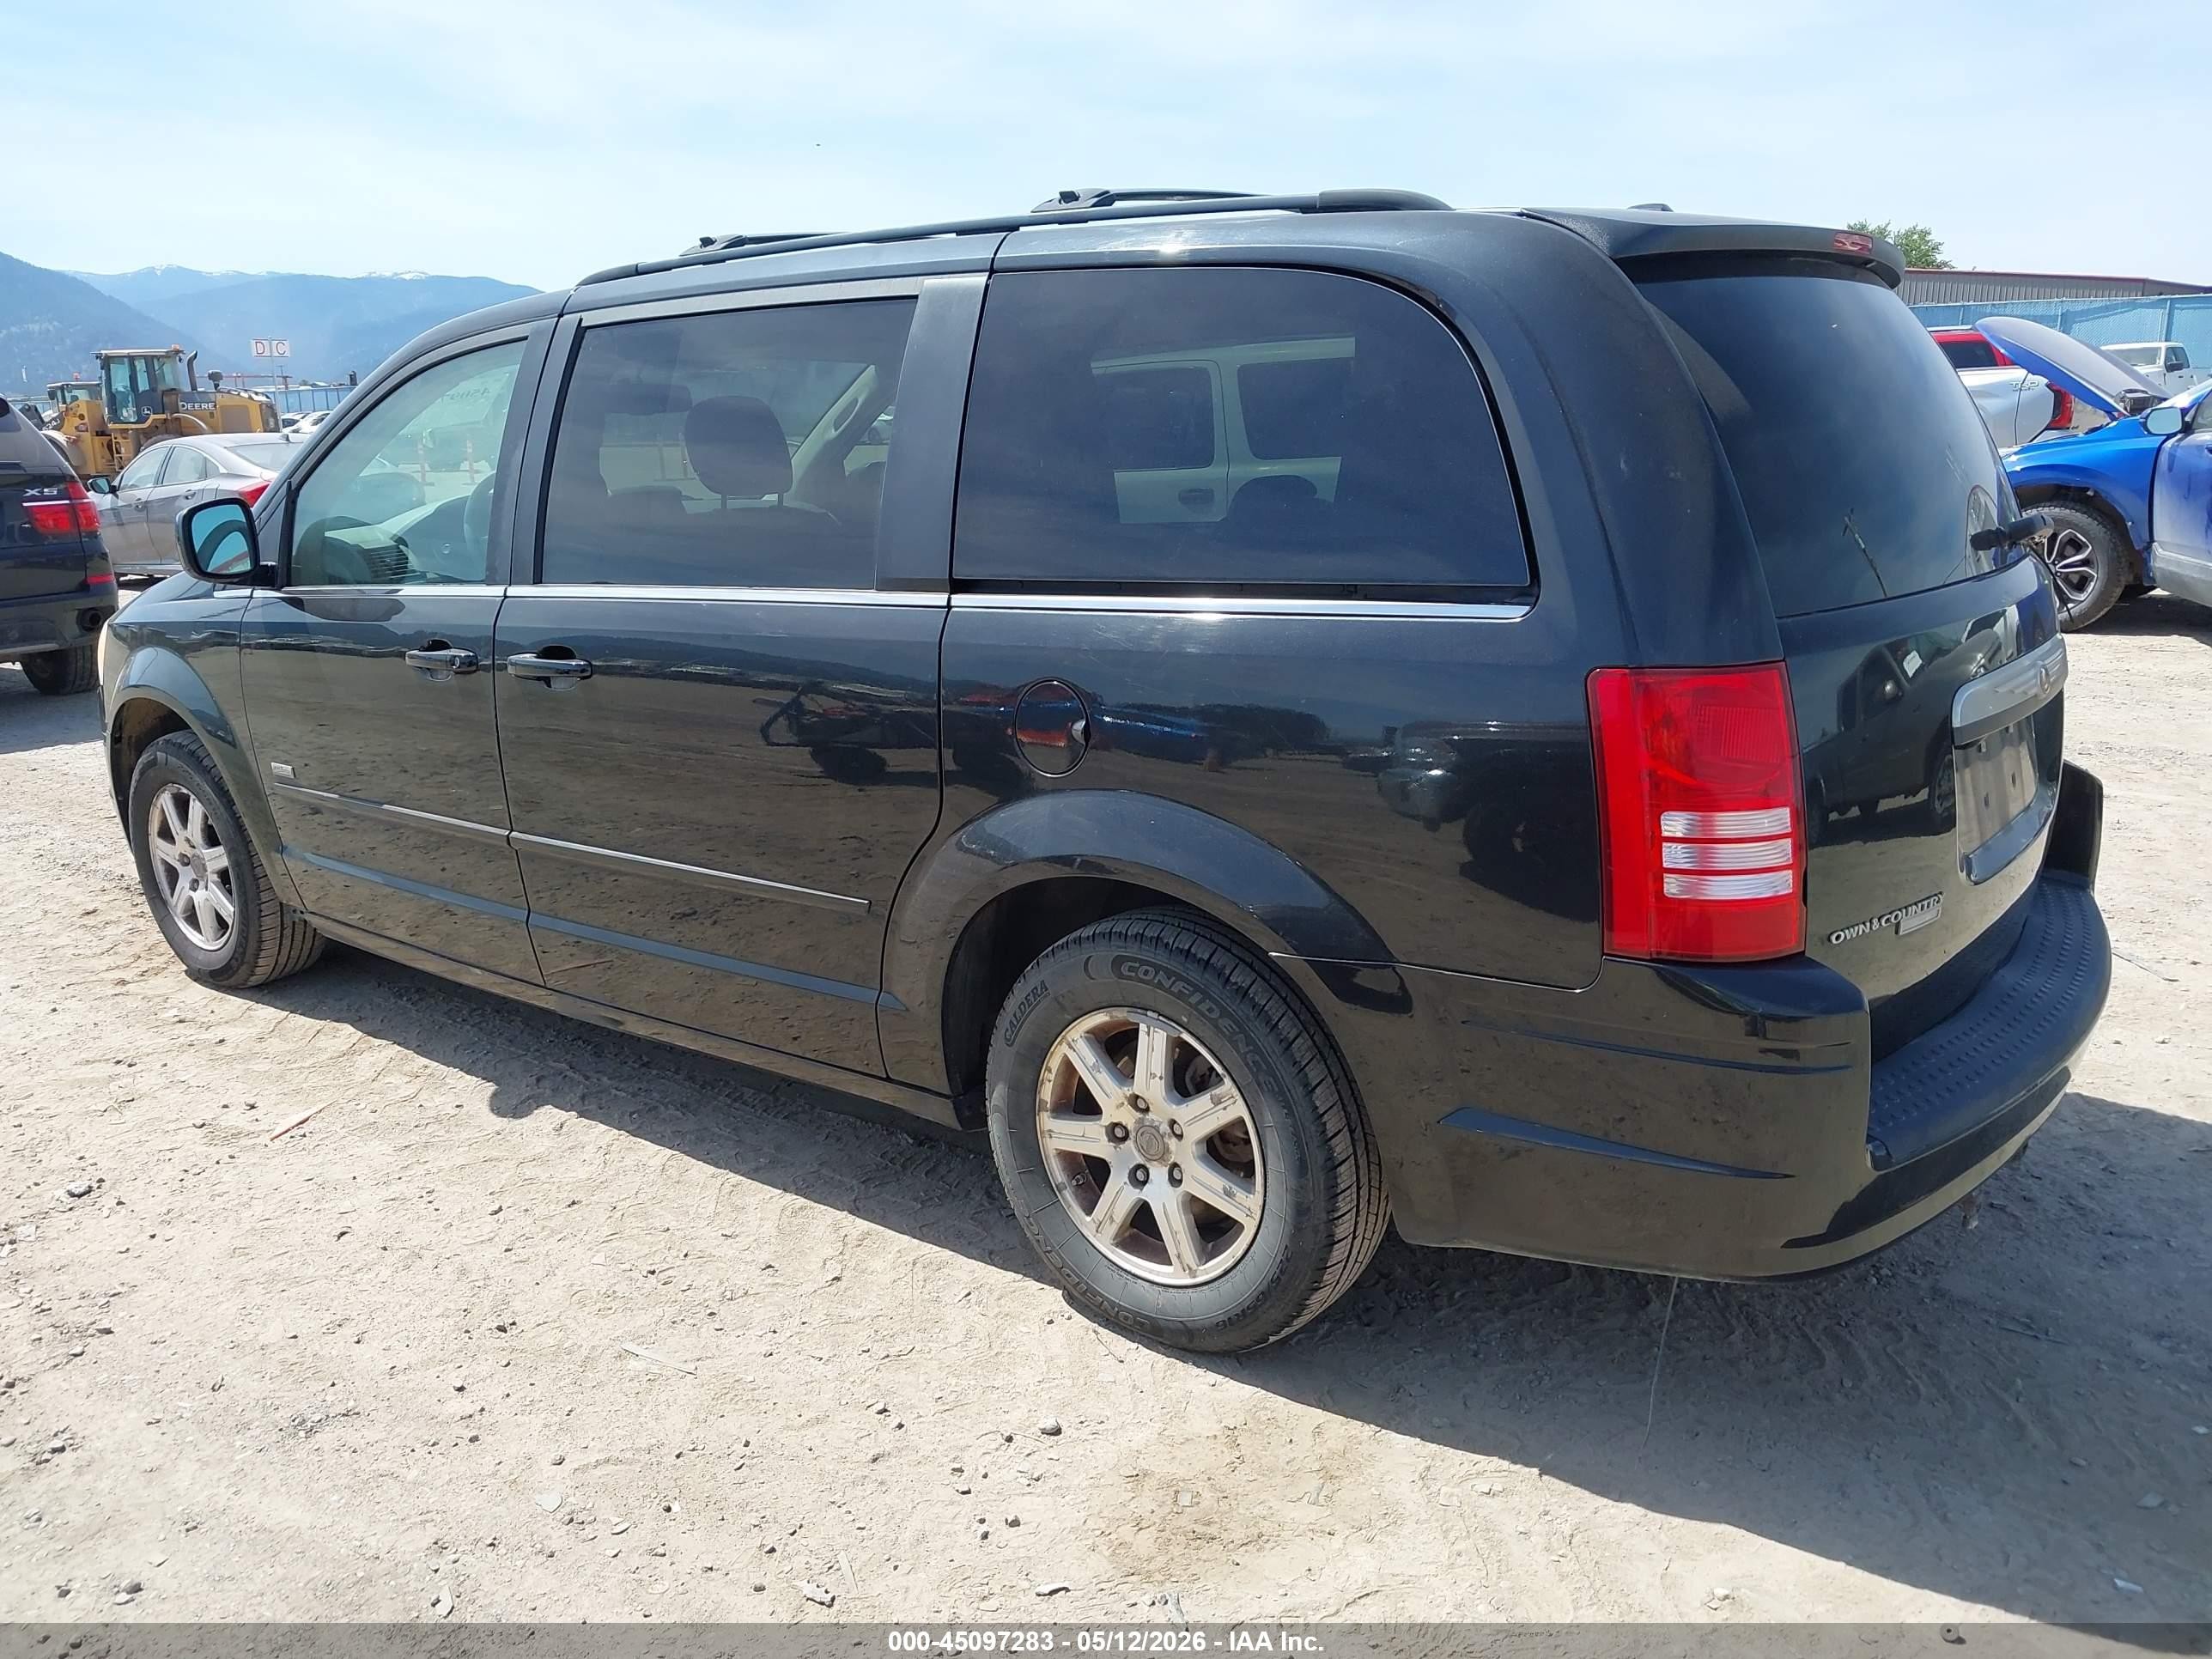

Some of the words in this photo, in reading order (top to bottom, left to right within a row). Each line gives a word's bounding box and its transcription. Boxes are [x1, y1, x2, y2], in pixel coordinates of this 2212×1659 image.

[254, 341, 265, 355] D
[276, 341, 287, 356] C
[179, 401, 216, 410] DEERE
[22, 487, 58, 497] X5
[1003, 979, 1049, 1043] CALDERA
[1120, 960, 1279, 1093] CONFIDENCE
